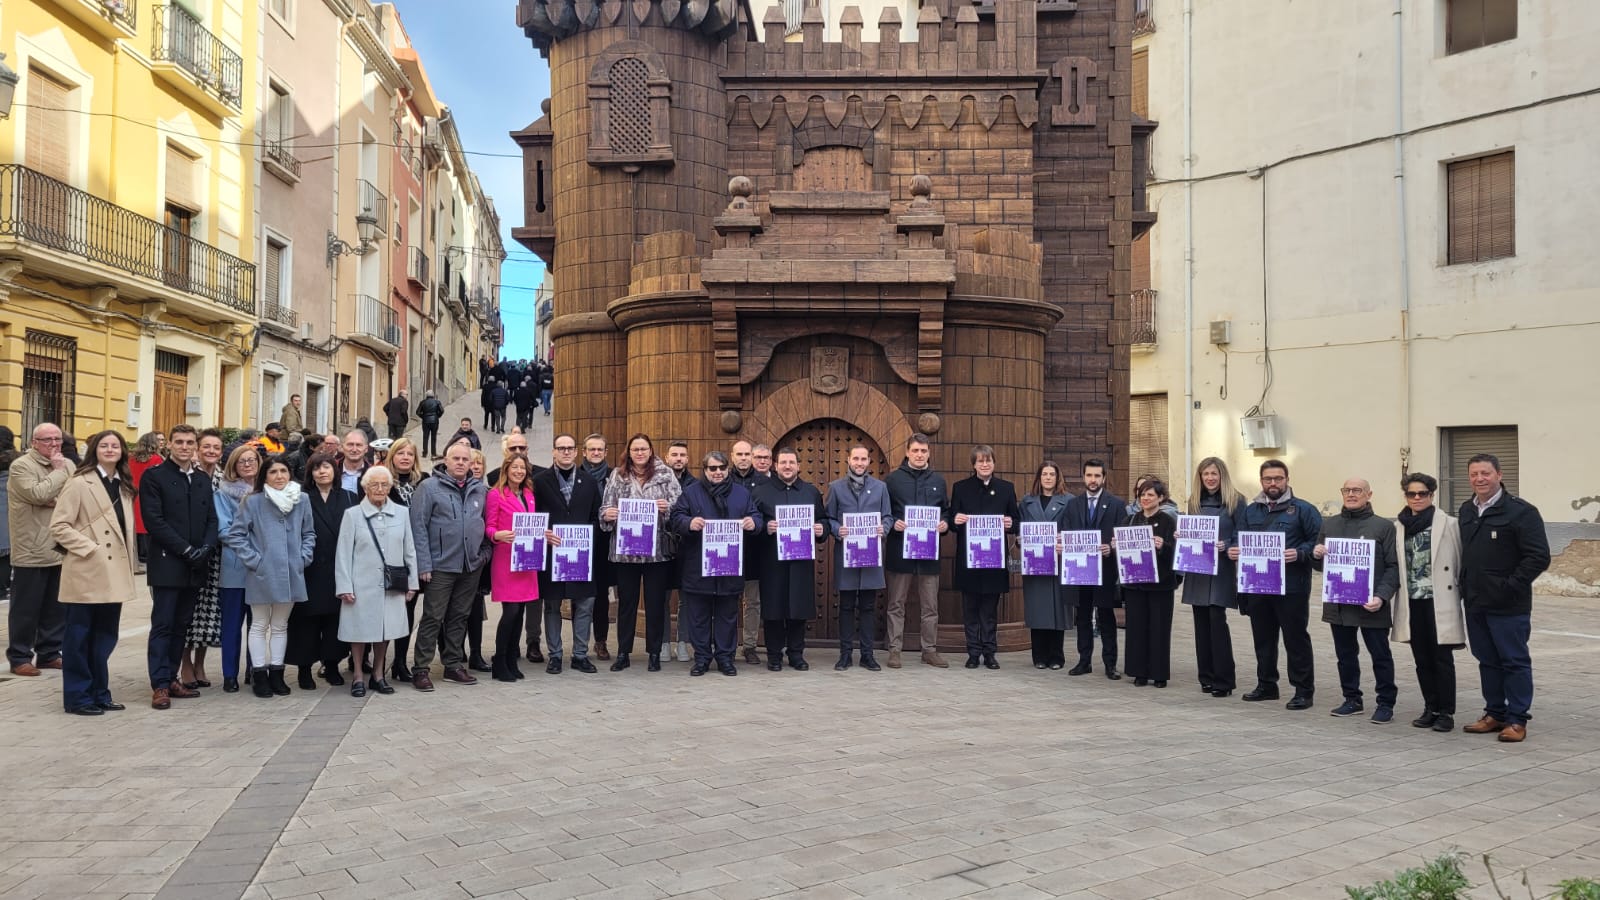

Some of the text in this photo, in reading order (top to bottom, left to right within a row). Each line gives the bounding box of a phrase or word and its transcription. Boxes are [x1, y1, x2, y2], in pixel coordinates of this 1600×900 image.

[621, 502, 654, 514] QUE LA FESTA
[779, 507, 810, 519] QUE LA FESTA
[908, 508, 938, 520] QUE LA FESTA
[516, 516, 545, 527] QUE LA FESTA
[846, 516, 878, 527] QUE LA FESTA
[970, 518, 1002, 528] QUE LA FESTA
[1180, 518, 1216, 530] QUE LA FESTA
[567, 528, 573, 539] LA
[574, 528, 590, 539] FESTA
[706, 522, 740, 534] QUE LA FESTA
[1024, 525, 1054, 536] QUE LA FESTA
[1064, 533, 1098, 544] QUE LA FESTA
[1117, 528, 1150, 541] QUE LA FESTA
[1242, 534, 1281, 548] QUE LA FESTA
[1328, 541, 1370, 556] QUE LA FESTA
